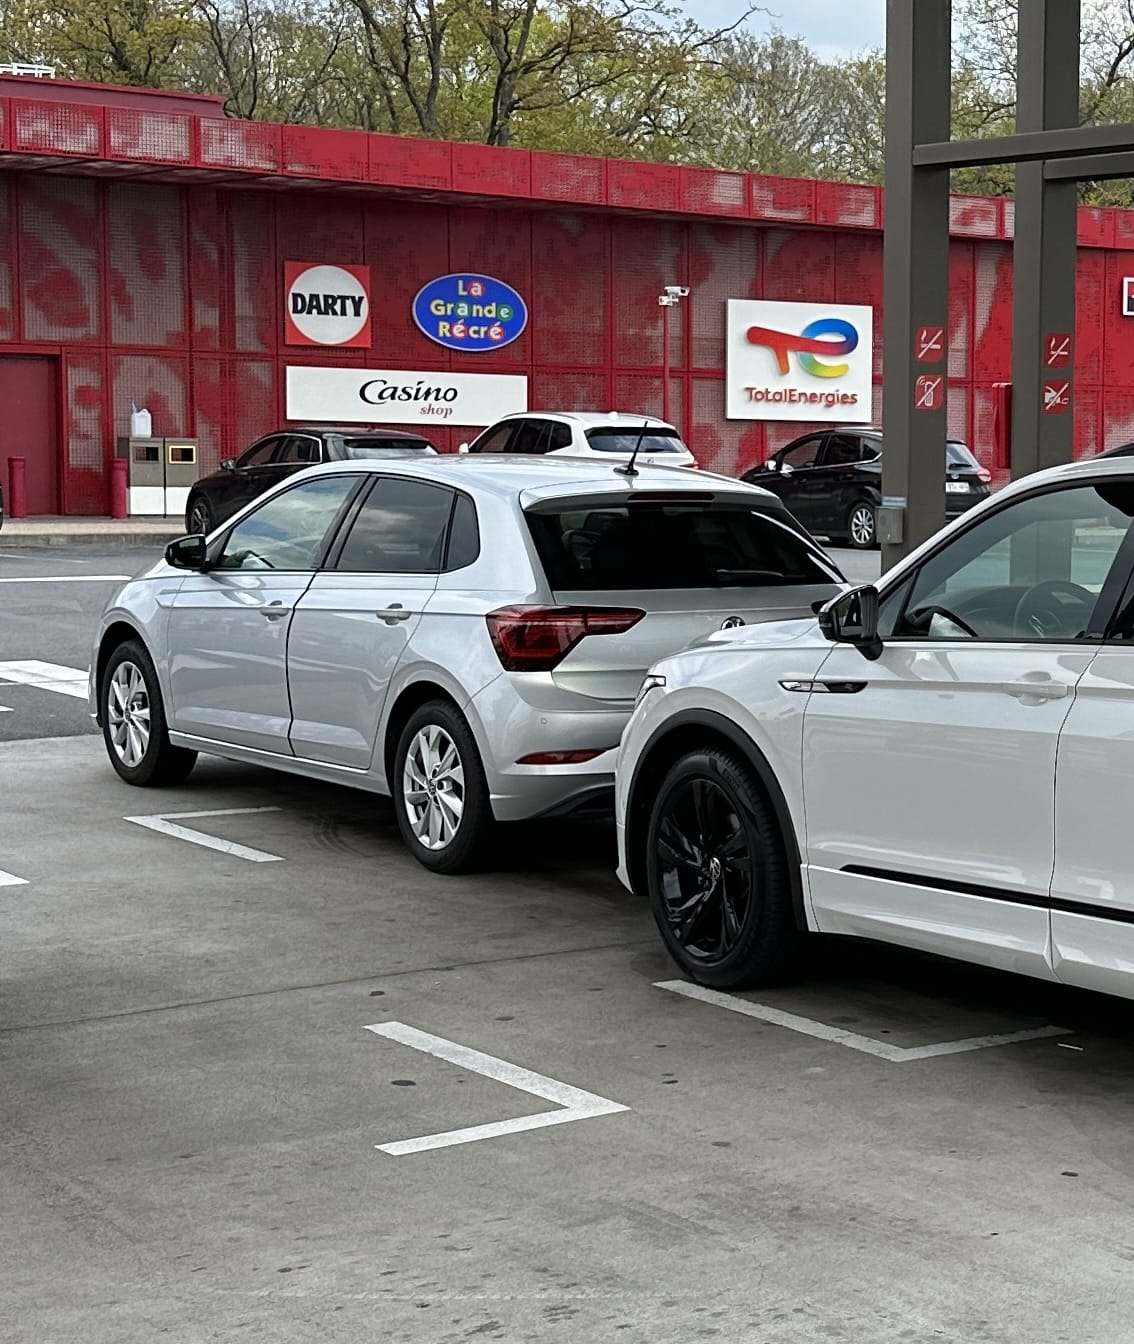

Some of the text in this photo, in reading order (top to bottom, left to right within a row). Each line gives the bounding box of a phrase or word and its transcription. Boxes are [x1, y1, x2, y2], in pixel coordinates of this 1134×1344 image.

[458, 279, 484, 296] La
[291, 292, 365, 317] DARTY
[430, 299, 511, 319] Grande
[438, 319, 503, 339] Récré
[359, 379, 458, 405] Casino
[744, 387, 858, 408] TotalEnergies
[419, 403, 453, 419] shop
